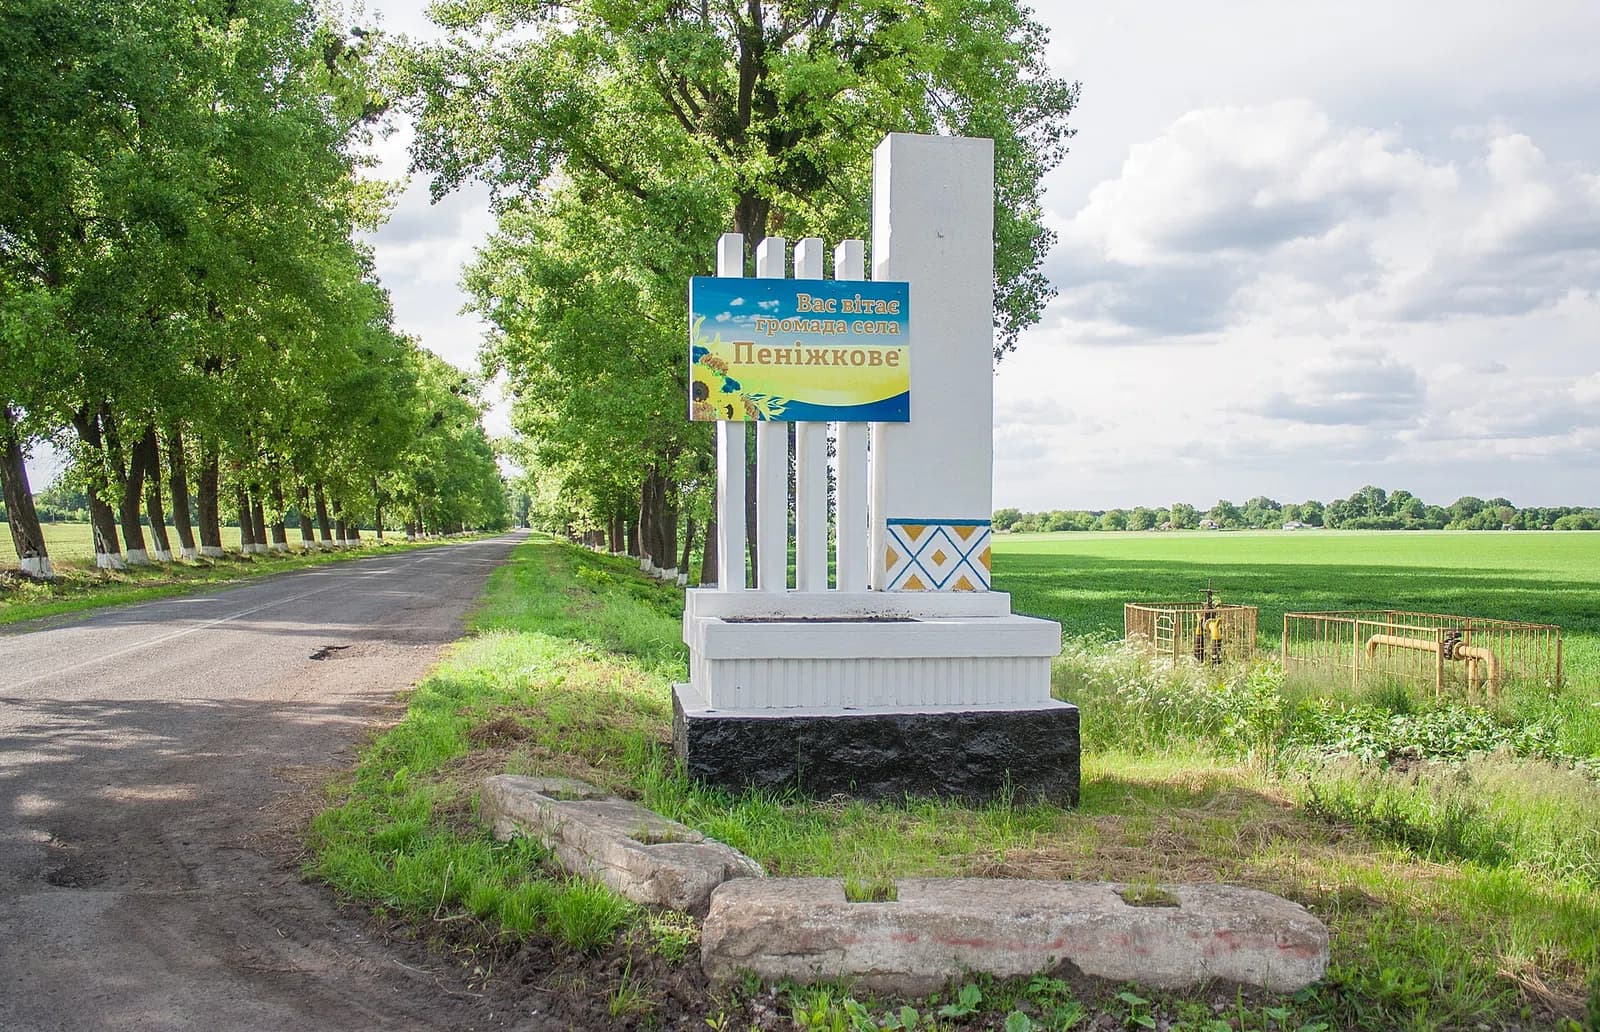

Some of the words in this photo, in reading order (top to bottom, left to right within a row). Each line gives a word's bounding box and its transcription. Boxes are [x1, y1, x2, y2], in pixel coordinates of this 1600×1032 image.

[796, 293, 837, 313] Вас
[841, 294, 900, 314] вітає
[755, 318, 847, 336] громада
[852, 319, 900, 335] села
[733, 341, 900, 367] Пеніжкове
